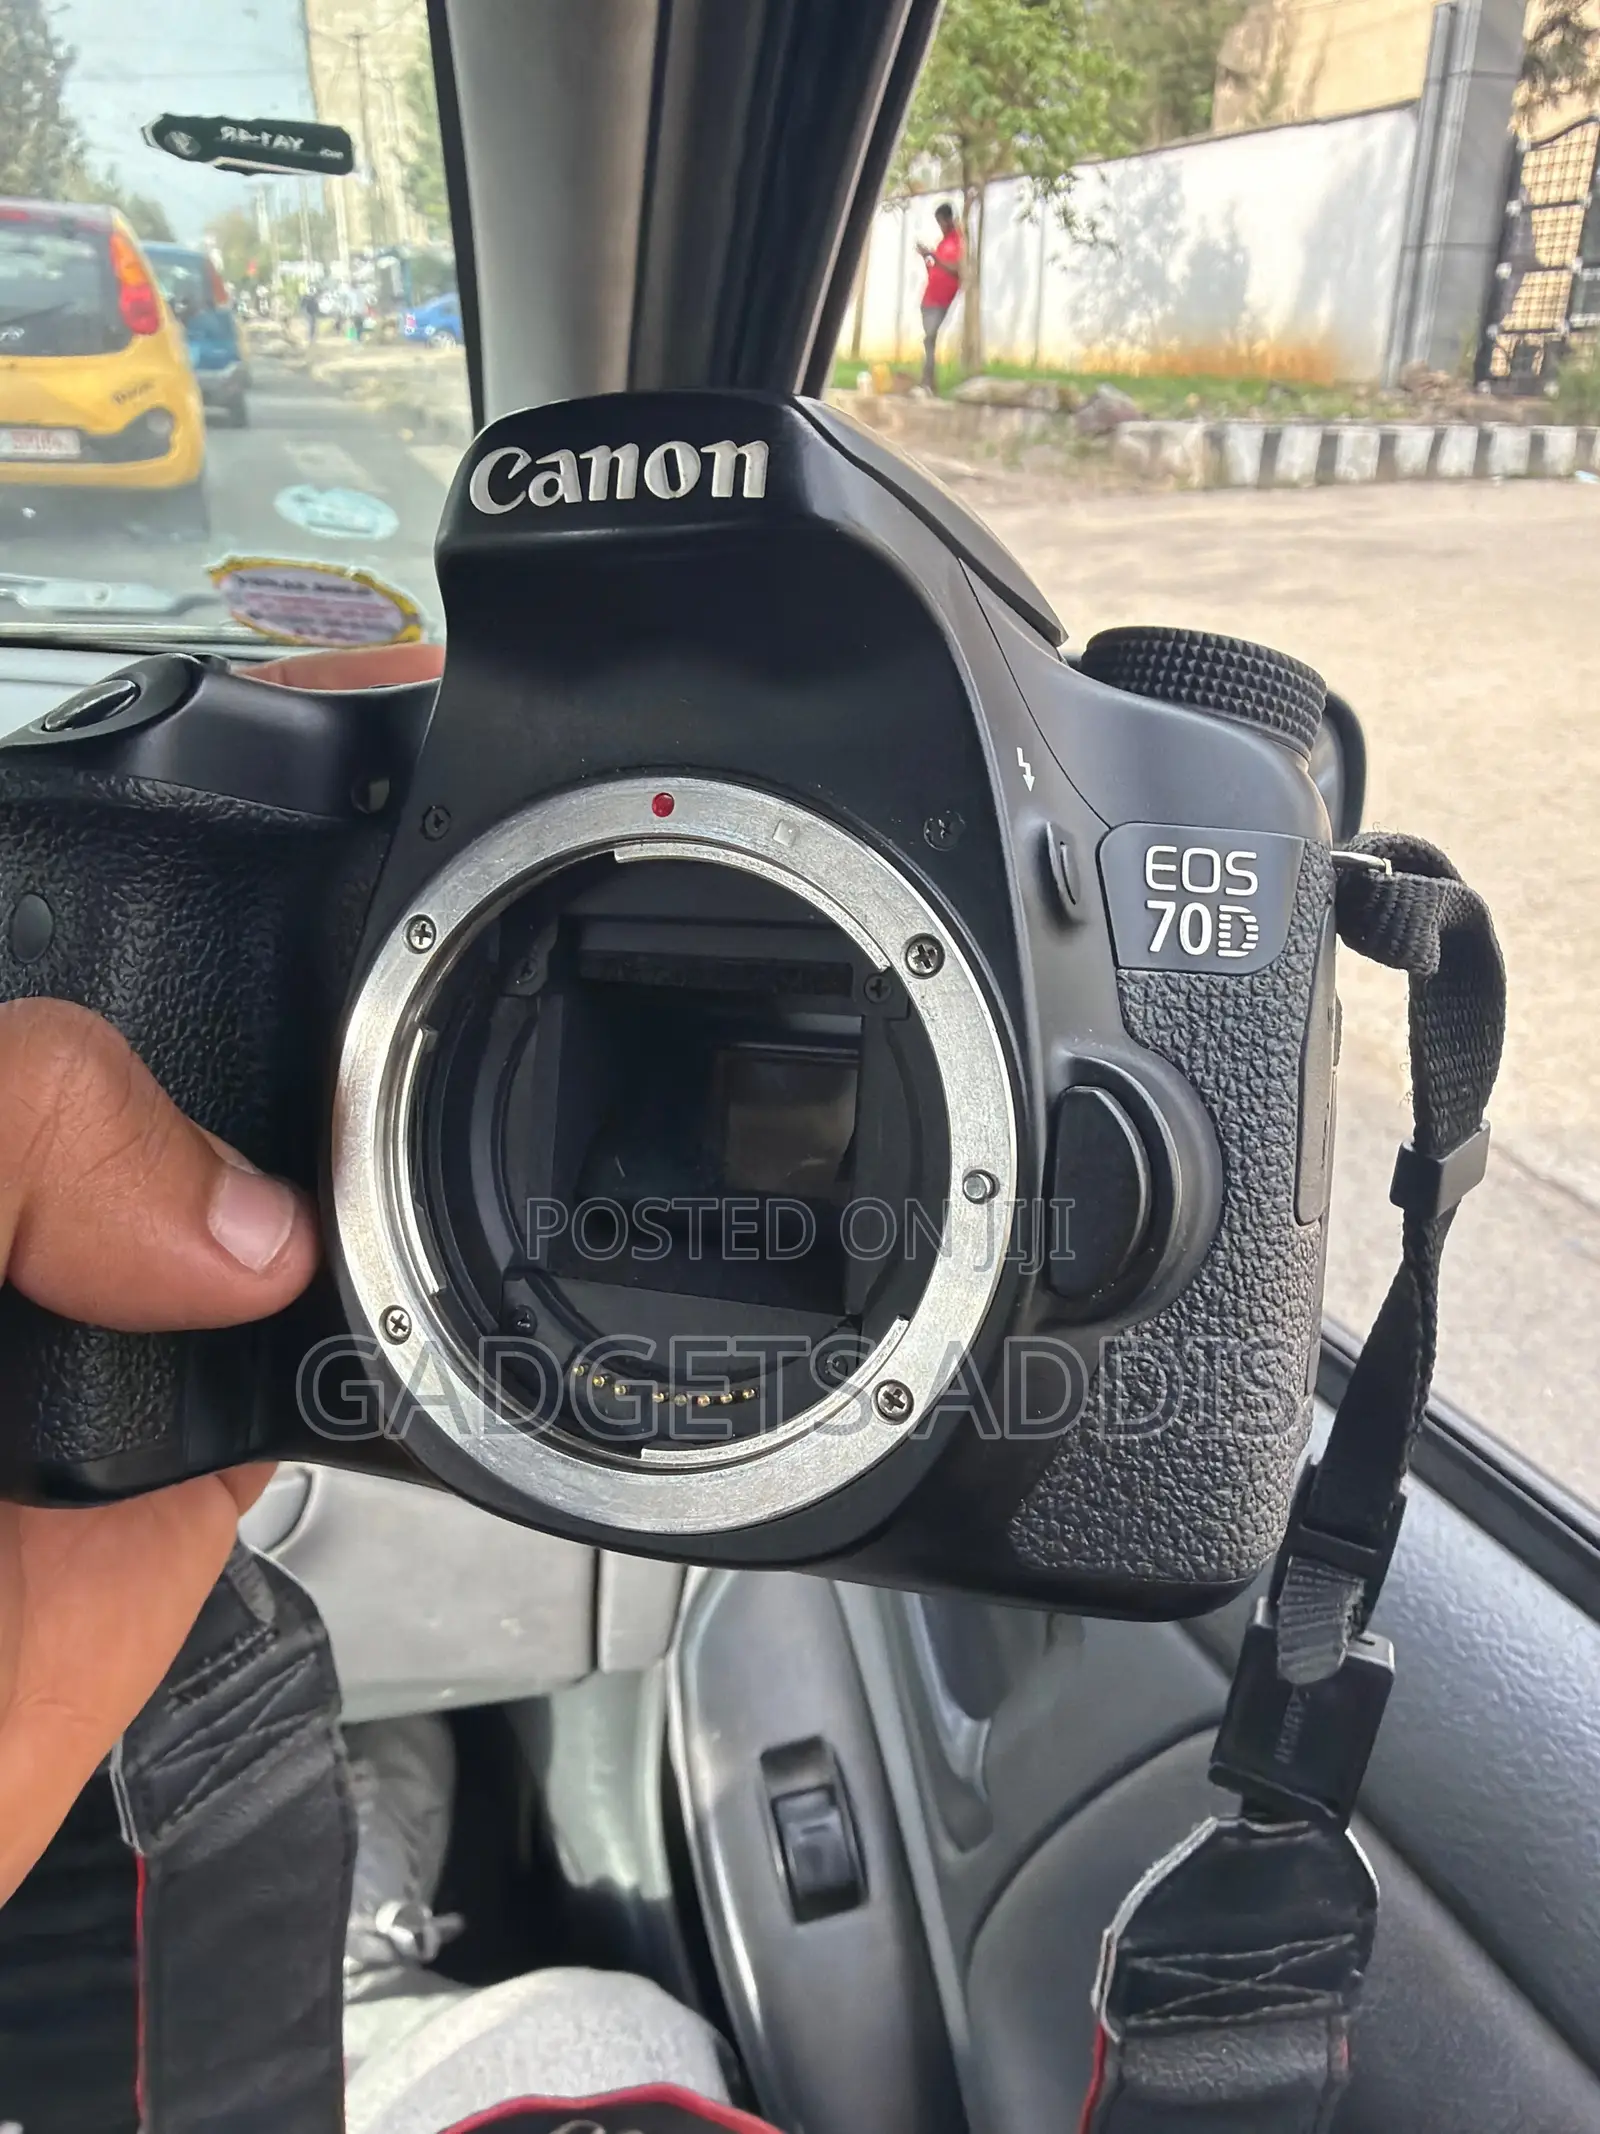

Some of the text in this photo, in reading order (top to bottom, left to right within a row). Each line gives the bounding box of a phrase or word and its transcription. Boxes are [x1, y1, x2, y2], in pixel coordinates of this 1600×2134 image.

[469, 440, 769, 515] Canon
[1145, 845, 1259, 897] EOS
[1146, 899, 1259, 958] 70D
